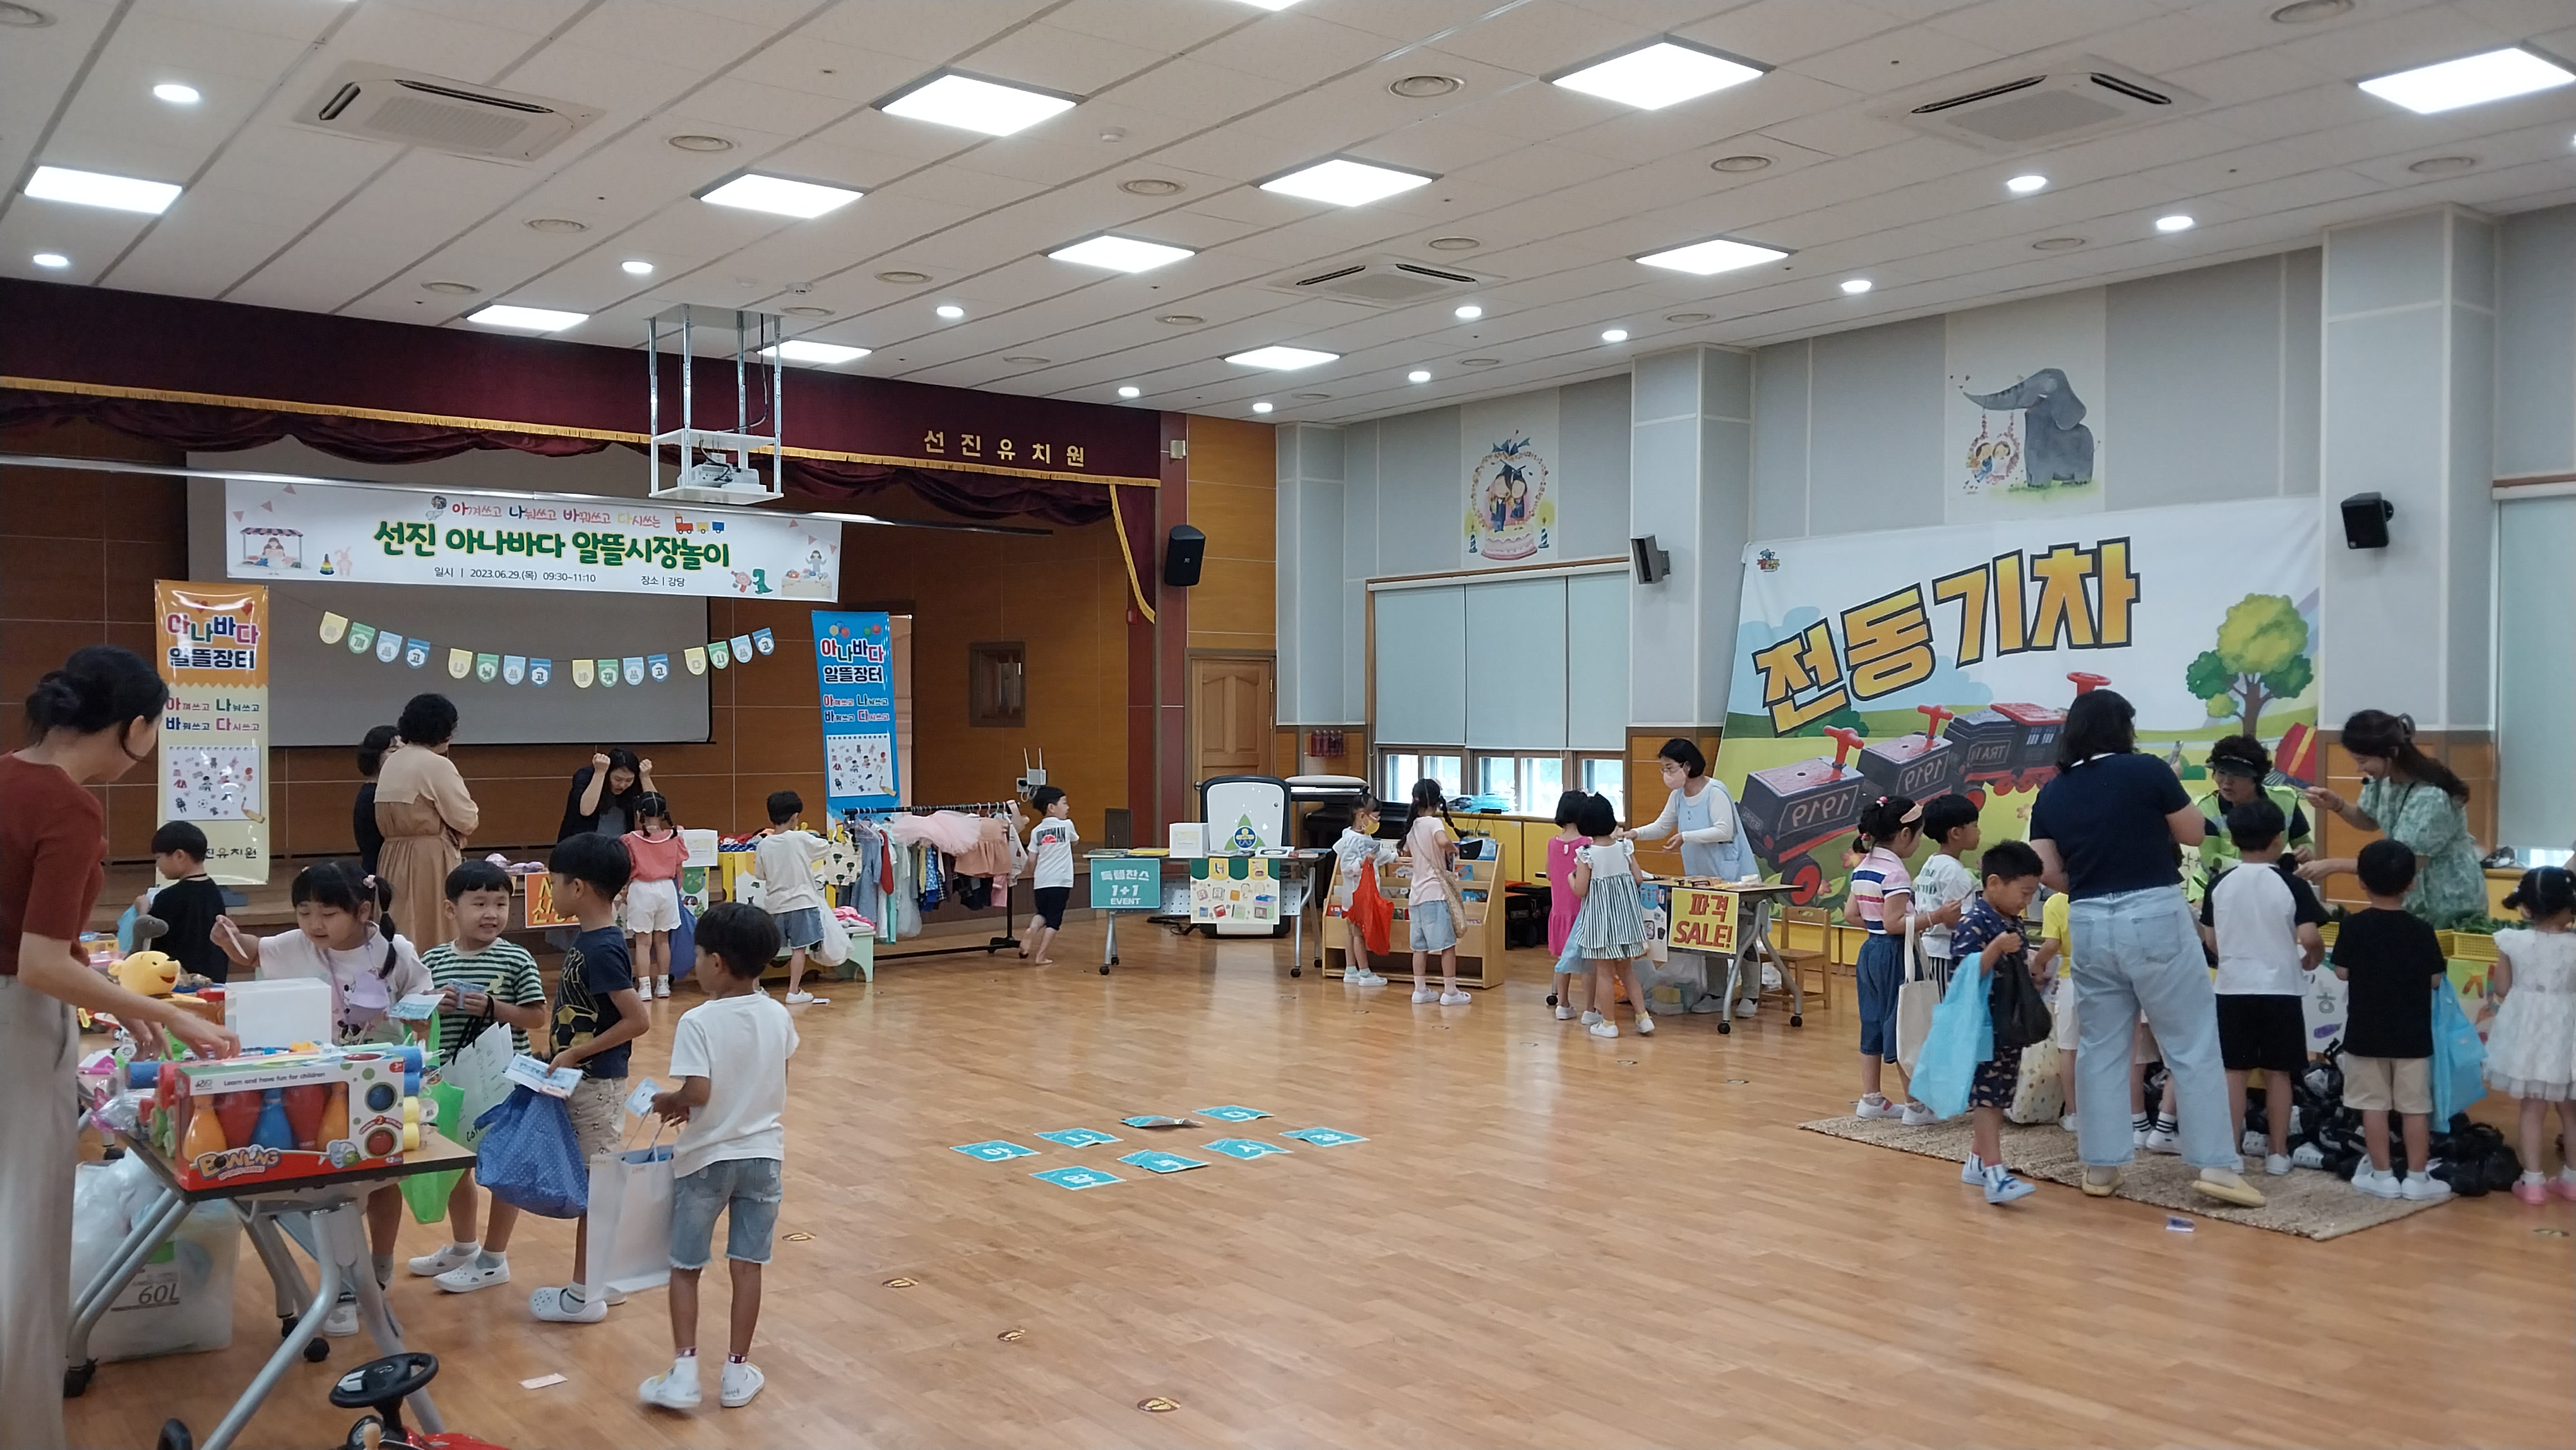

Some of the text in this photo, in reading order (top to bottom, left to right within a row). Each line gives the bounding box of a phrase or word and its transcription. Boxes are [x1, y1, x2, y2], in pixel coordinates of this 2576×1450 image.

[924, 430, 1084, 467] 선진유치원
[451, 502, 661, 528] 아껴쓰고 나눠쓰고 바꿔쓰고 다시쓰는
[374, 520, 730, 571] 선진 아나바다 알뜰시장놀이
[434, 566, 686, 587] 일시 2023.06.29.(목) 09:30~11:10 장소 강당
[167, 614, 259, 644] 아나바다
[1751, 536, 2141, 738] 전동기차
[169, 647, 255, 669] 알뜰장터
[821, 639, 884, 662] 아나바다
[824, 666, 883, 682] 알뜰장터
[165, 697, 259, 712] 아껴쓰고 나눠쓰고
[165, 716, 259, 731] 바꿔쓰고 다시쓰고
[205, 846, 257, 860] 진유치원
[1111, 884, 1140, 897] 1+1
[1688, 893, 1729, 923] 파격
[1673, 920, 1733, 949] SALE!
[138, 1283, 180, 1304] 60L
